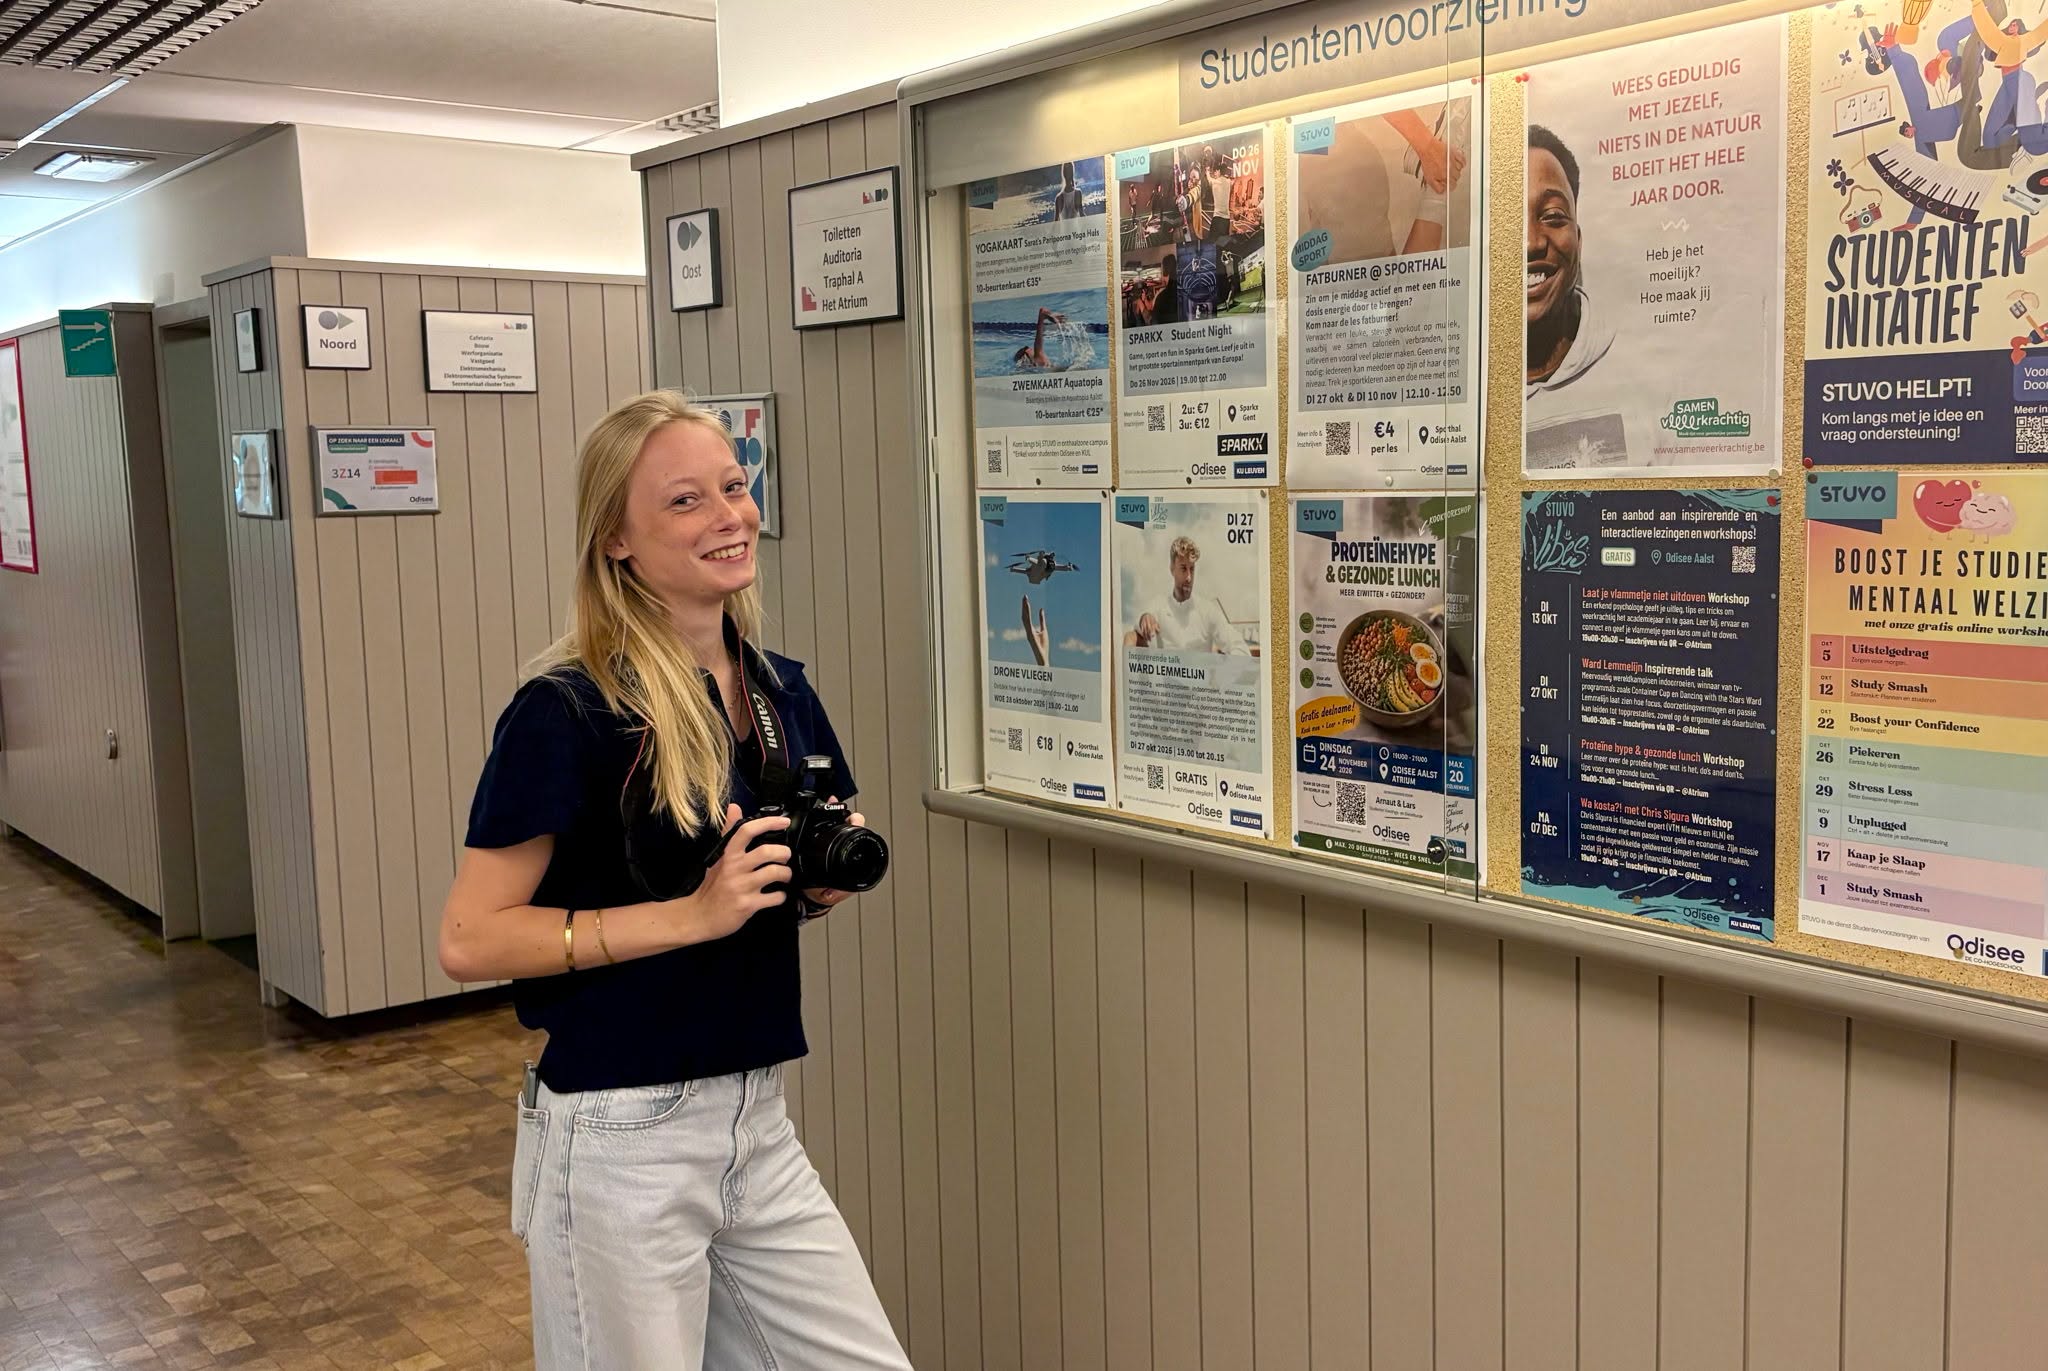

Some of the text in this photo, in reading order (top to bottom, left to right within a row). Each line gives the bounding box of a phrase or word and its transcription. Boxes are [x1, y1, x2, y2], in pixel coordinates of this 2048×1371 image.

[1612, 58, 1740, 96] WEES GEDULDIG
[1629, 92, 1722, 122] MET JEZELF,
[1599, 114, 1761, 155] NIETS IN DE NATUUR
[1233, 144, 1259, 159] DO 26
[1121, 156, 1145, 169] STUVO
[1233, 160, 1258, 178] NOV
[1612, 146, 1745, 181] BLOEIT HET HELE
[1631, 179, 1724, 207] JAAR DOOR.
[1881, 171, 1965, 220] MUSICAL
[823, 226, 861, 242] Toiletten
[976, 238, 1023, 254] YOGAKAART
[1295, 233, 1328, 255] MIDDAG
[823, 248, 862, 265] Auditoria
[1299, 247, 1326, 267] SPORT
[1646, 245, 1704, 261] Heb je het
[1824, 215, 2029, 292] STUDENTEN
[682, 265, 702, 279] Oost
[1306, 257, 1447, 285] FATBURNER @ SPORTHAL
[1649, 266, 1700, 282] moeilijk?
[824, 271, 863, 289] Traphal A
[1640, 286, 1710, 304] Hoe maak jij
[823, 296, 867, 312] Het Atrium
[1654, 309, 1696, 324] ruimte?
[1825, 282, 1982, 349] INITATIEF
[1129, 325, 1232, 344] SPARKX Student Night
[320, 339, 356, 350] Noord
[1013, 377, 1102, 391] ZWEMKAART Aquatopia
[1822, 378, 1972, 402] STUVO HELPT!
[1182, 403, 1208, 414] 2u: €7
[1677, 401, 1714, 413] SAMEN
[1179, 418, 1210, 430] 3u: €12
[1822, 410, 1984, 426] Kom langs met je idee en
[1374, 422, 1394, 438] €4
[1821, 426, 1960, 442] vraag ondersteuning!
[1221, 434, 1265, 452] SPARKX
[1371, 444, 1398, 455] per les
[1654, 443, 1765, 454] www.samenveerkrachtig.be
[332, 469, 360, 478] 3Z14
[1192, 463, 1226, 475] Odisee
[1820, 486, 1886, 502] STUVO
[1304, 509, 1336, 520] STUVO
[1546, 501, 1575, 517] STUVO
[1601, 510, 1757, 523] Een aanbod aan inspirerende en
[1227, 514, 1253, 525] DI 27
[1227, 530, 1253, 543] OKT
[1331, 537, 1436, 564] PROTEÏNEHYPE
[1605, 552, 1631, 562] GRATIS
[1666, 553, 1714, 564] Odisee Aalst
[1835, 548, 2047, 579] BOOST JE STUDIE
[1326, 566, 1440, 588] & GEZONDE LUNCH
[1582, 588, 1749, 605] Laat je vlammetje niet uitdoven Workshop
[1849, 585, 2047, 619] MENTAAL WELZI
[1541, 601, 1549, 612] DI
[1532, 613, 1557, 624] 13 OKT
[1851, 644, 1929, 659] Uitstelgedrag
[994, 666, 1052, 682] DRONE VLIEGEN
[1129, 663, 1205, 680] WARD LEMMELIJN
[1851, 679, 1928, 693] Study Smash
[752, 693, 778, 749] Canon
[1850, 713, 1980, 733] Boost your Confidence
[1037, 736, 1053, 750] €18
[1320, 742, 1352, 755] DINSDAG
[1849, 746, 1900, 760] Piekeren
[1320, 755, 1367, 772] 24 NOVEMBER
[1339, 766, 1352, 774] 2026
[1175, 772, 1208, 786] GRATIS
[1392, 766, 1438, 778] ODISEE AALST
[1392, 775, 1415, 785] ATRIUM
[1848, 781, 1912, 797] Stress Less
[1848, 815, 1907, 831] Unplugged
[1847, 849, 1926, 869] Kaap je Slaap
[1947, 934, 2025, 963] Odisee
